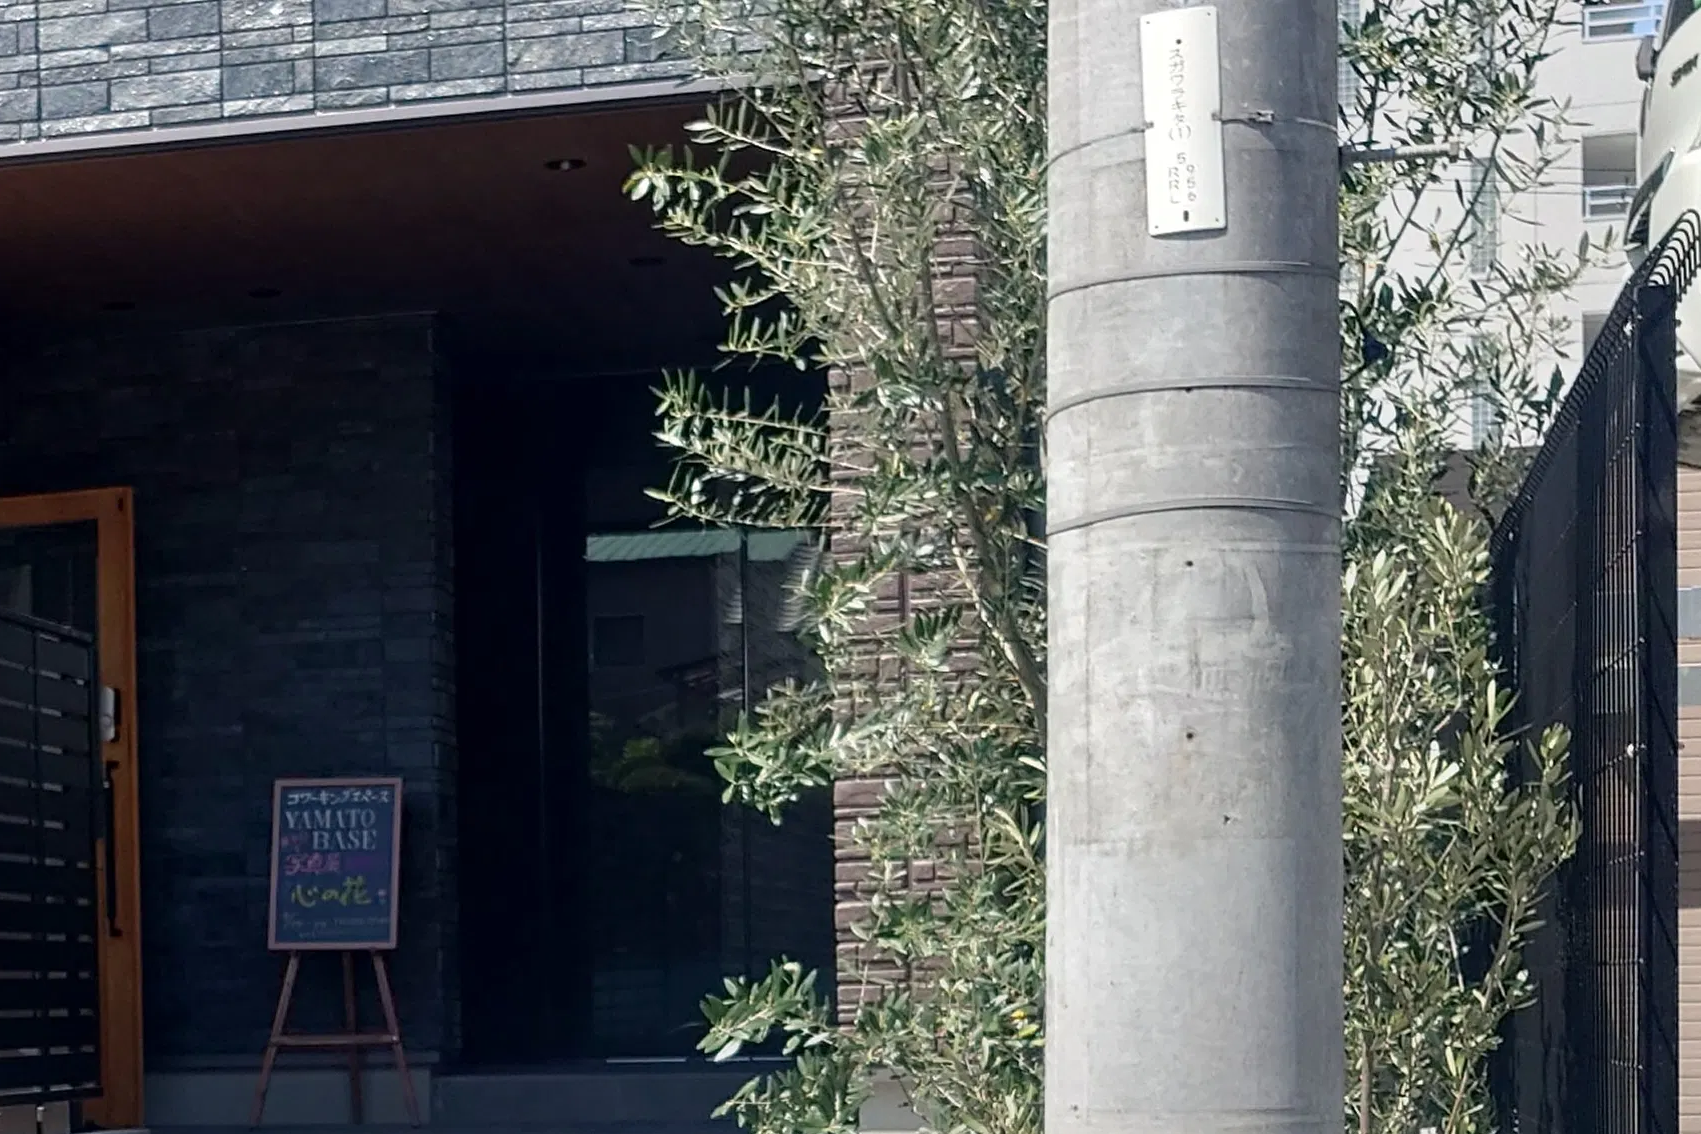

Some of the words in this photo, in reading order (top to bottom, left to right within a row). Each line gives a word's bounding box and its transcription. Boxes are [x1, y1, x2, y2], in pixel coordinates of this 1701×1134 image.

[287, 788, 391, 806] コワーキングスペース
[285, 808, 377, 829] YAMATO
[312, 829, 378, 850] BASE
[291, 875, 372, 909] 心の花
